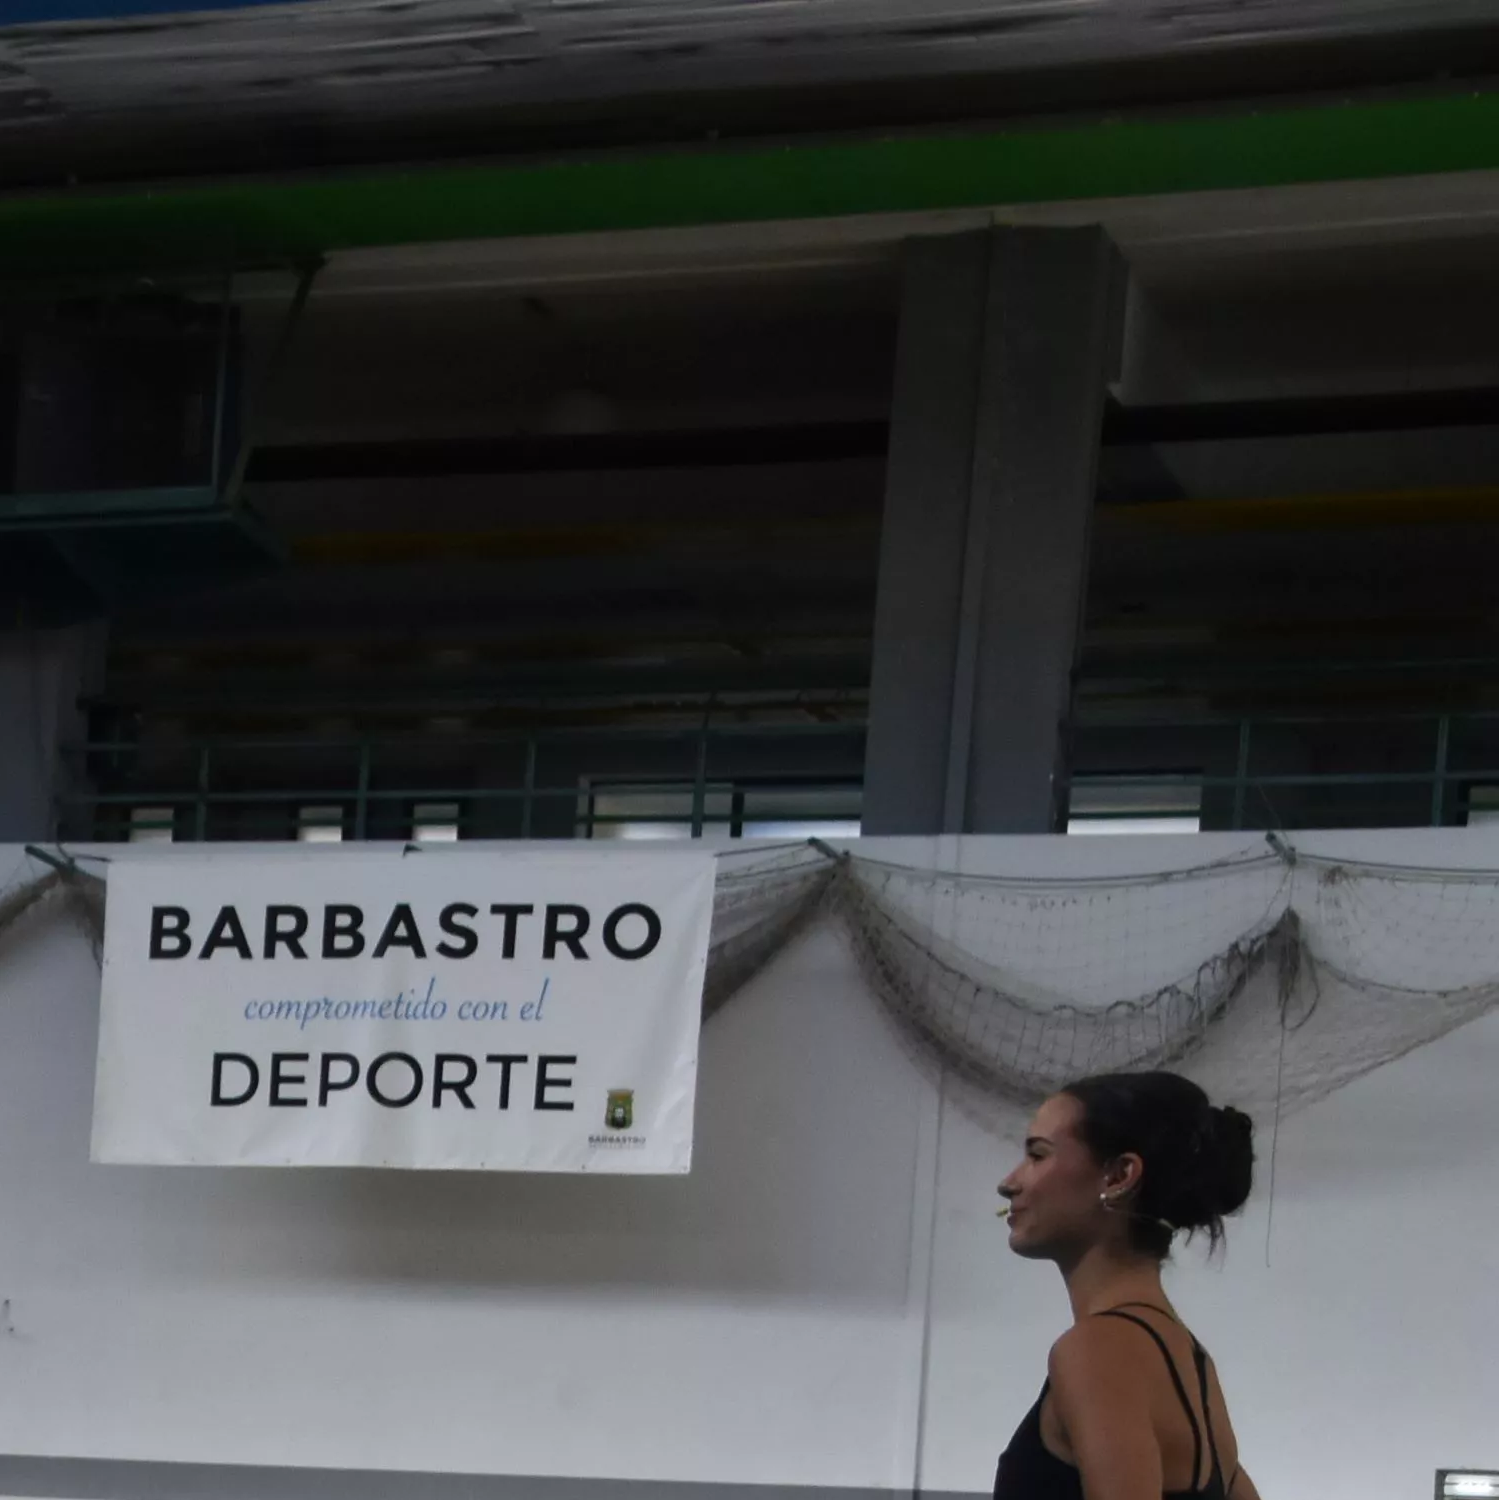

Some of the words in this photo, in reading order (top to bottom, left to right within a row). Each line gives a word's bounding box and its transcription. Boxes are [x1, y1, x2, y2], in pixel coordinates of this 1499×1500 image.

[148, 902, 663, 961] BARBASTRO
[243, 976, 447, 1030] comprometido
[458, 998, 508, 1021] con
[520, 977, 550, 1021] el
[209, 1051, 578, 1111] DEPORTE
